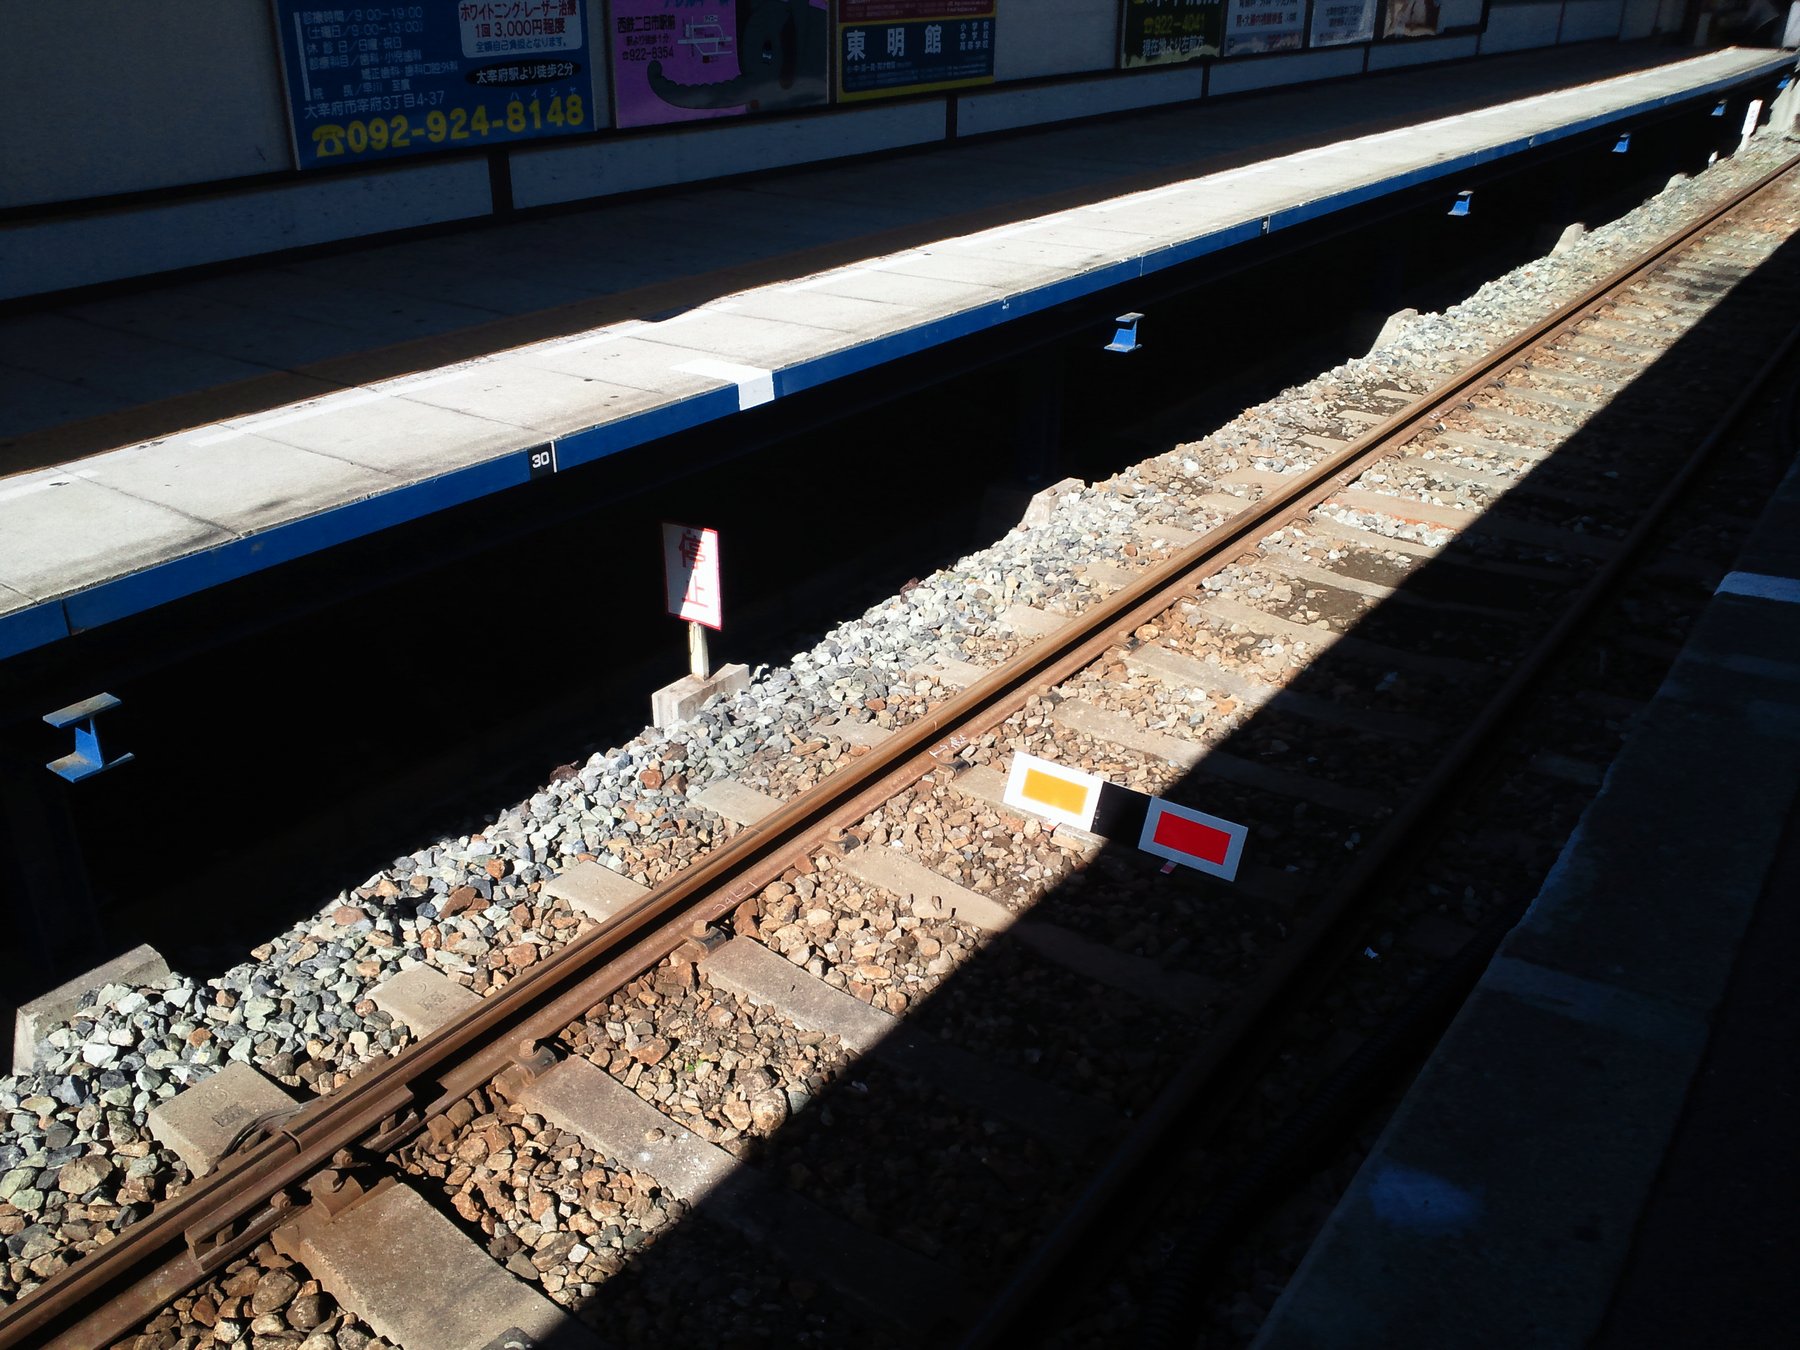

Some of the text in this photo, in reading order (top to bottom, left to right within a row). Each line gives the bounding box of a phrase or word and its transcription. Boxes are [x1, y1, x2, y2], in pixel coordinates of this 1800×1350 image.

[494, 18, 565, 37] 3,000円程度
[847, 24, 942, 60] 東明館
[347, 95, 584, 153] 092-924-8148
[532, 451, 550, 468] 30
[679, 529, 709, 608] 停止
